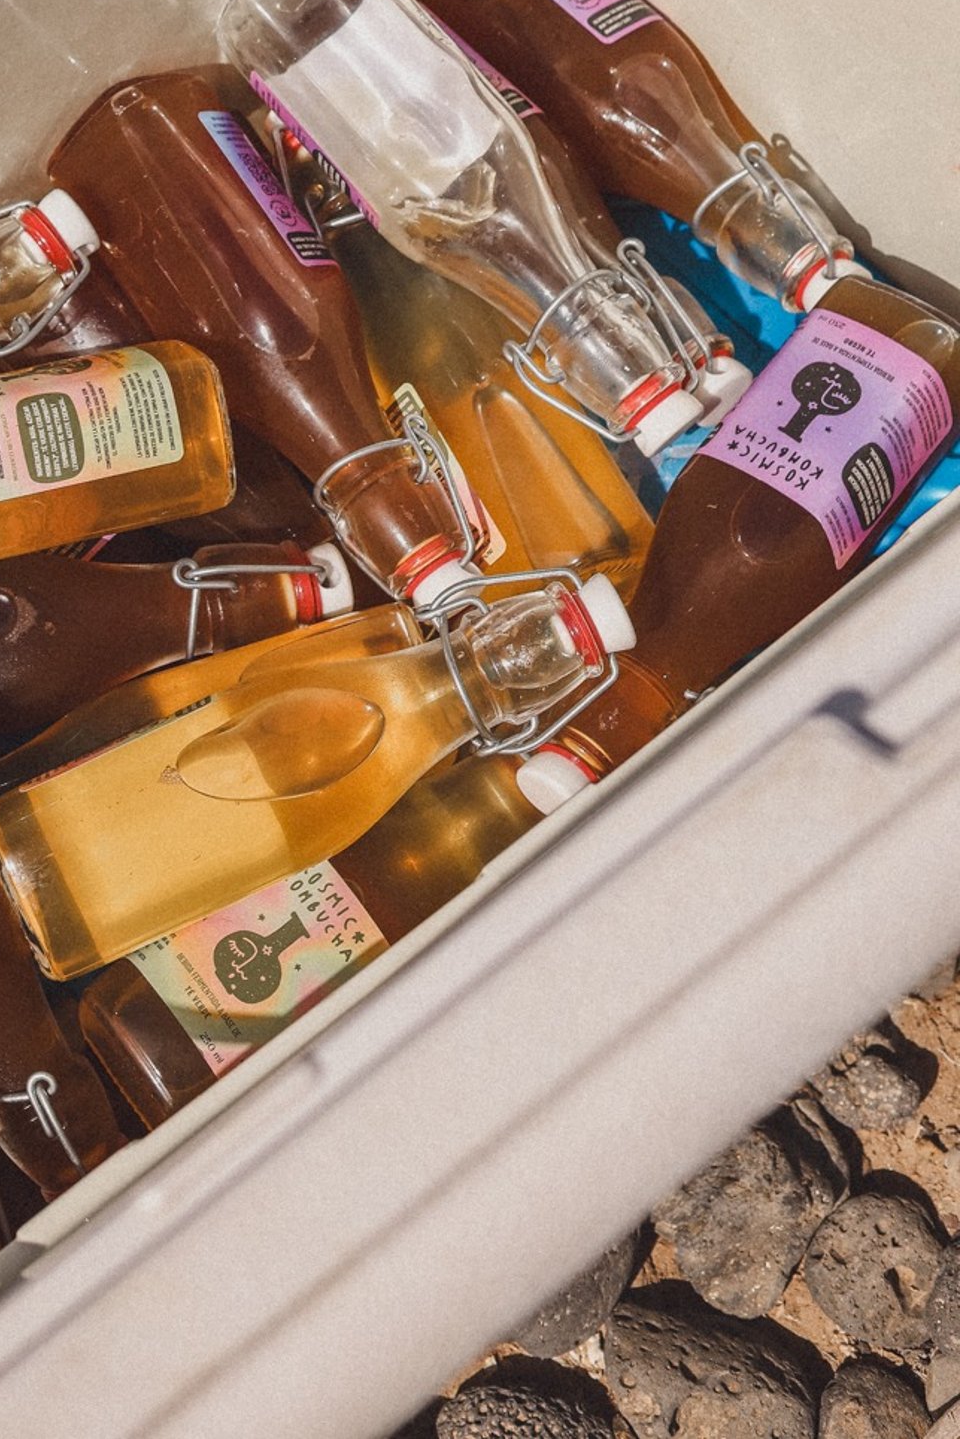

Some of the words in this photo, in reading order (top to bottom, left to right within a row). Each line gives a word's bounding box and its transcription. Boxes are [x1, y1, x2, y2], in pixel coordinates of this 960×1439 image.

[733, 425, 824, 478] KOMBUCHA
[740, 449, 808, 490] KOSMIC
[285, 879, 352, 962] OMBUCHA
[304, 870, 357, 931] OSMIC
[191, 971, 220, 1008] FERMENTADA
[221, 1012, 236, 1029] BASE
[232, 1028, 241, 1038] DE
[193, 996, 210, 1019] VERDE
[199, 1032, 215, 1051] 250
[213, 1051, 224, 1064] ml
